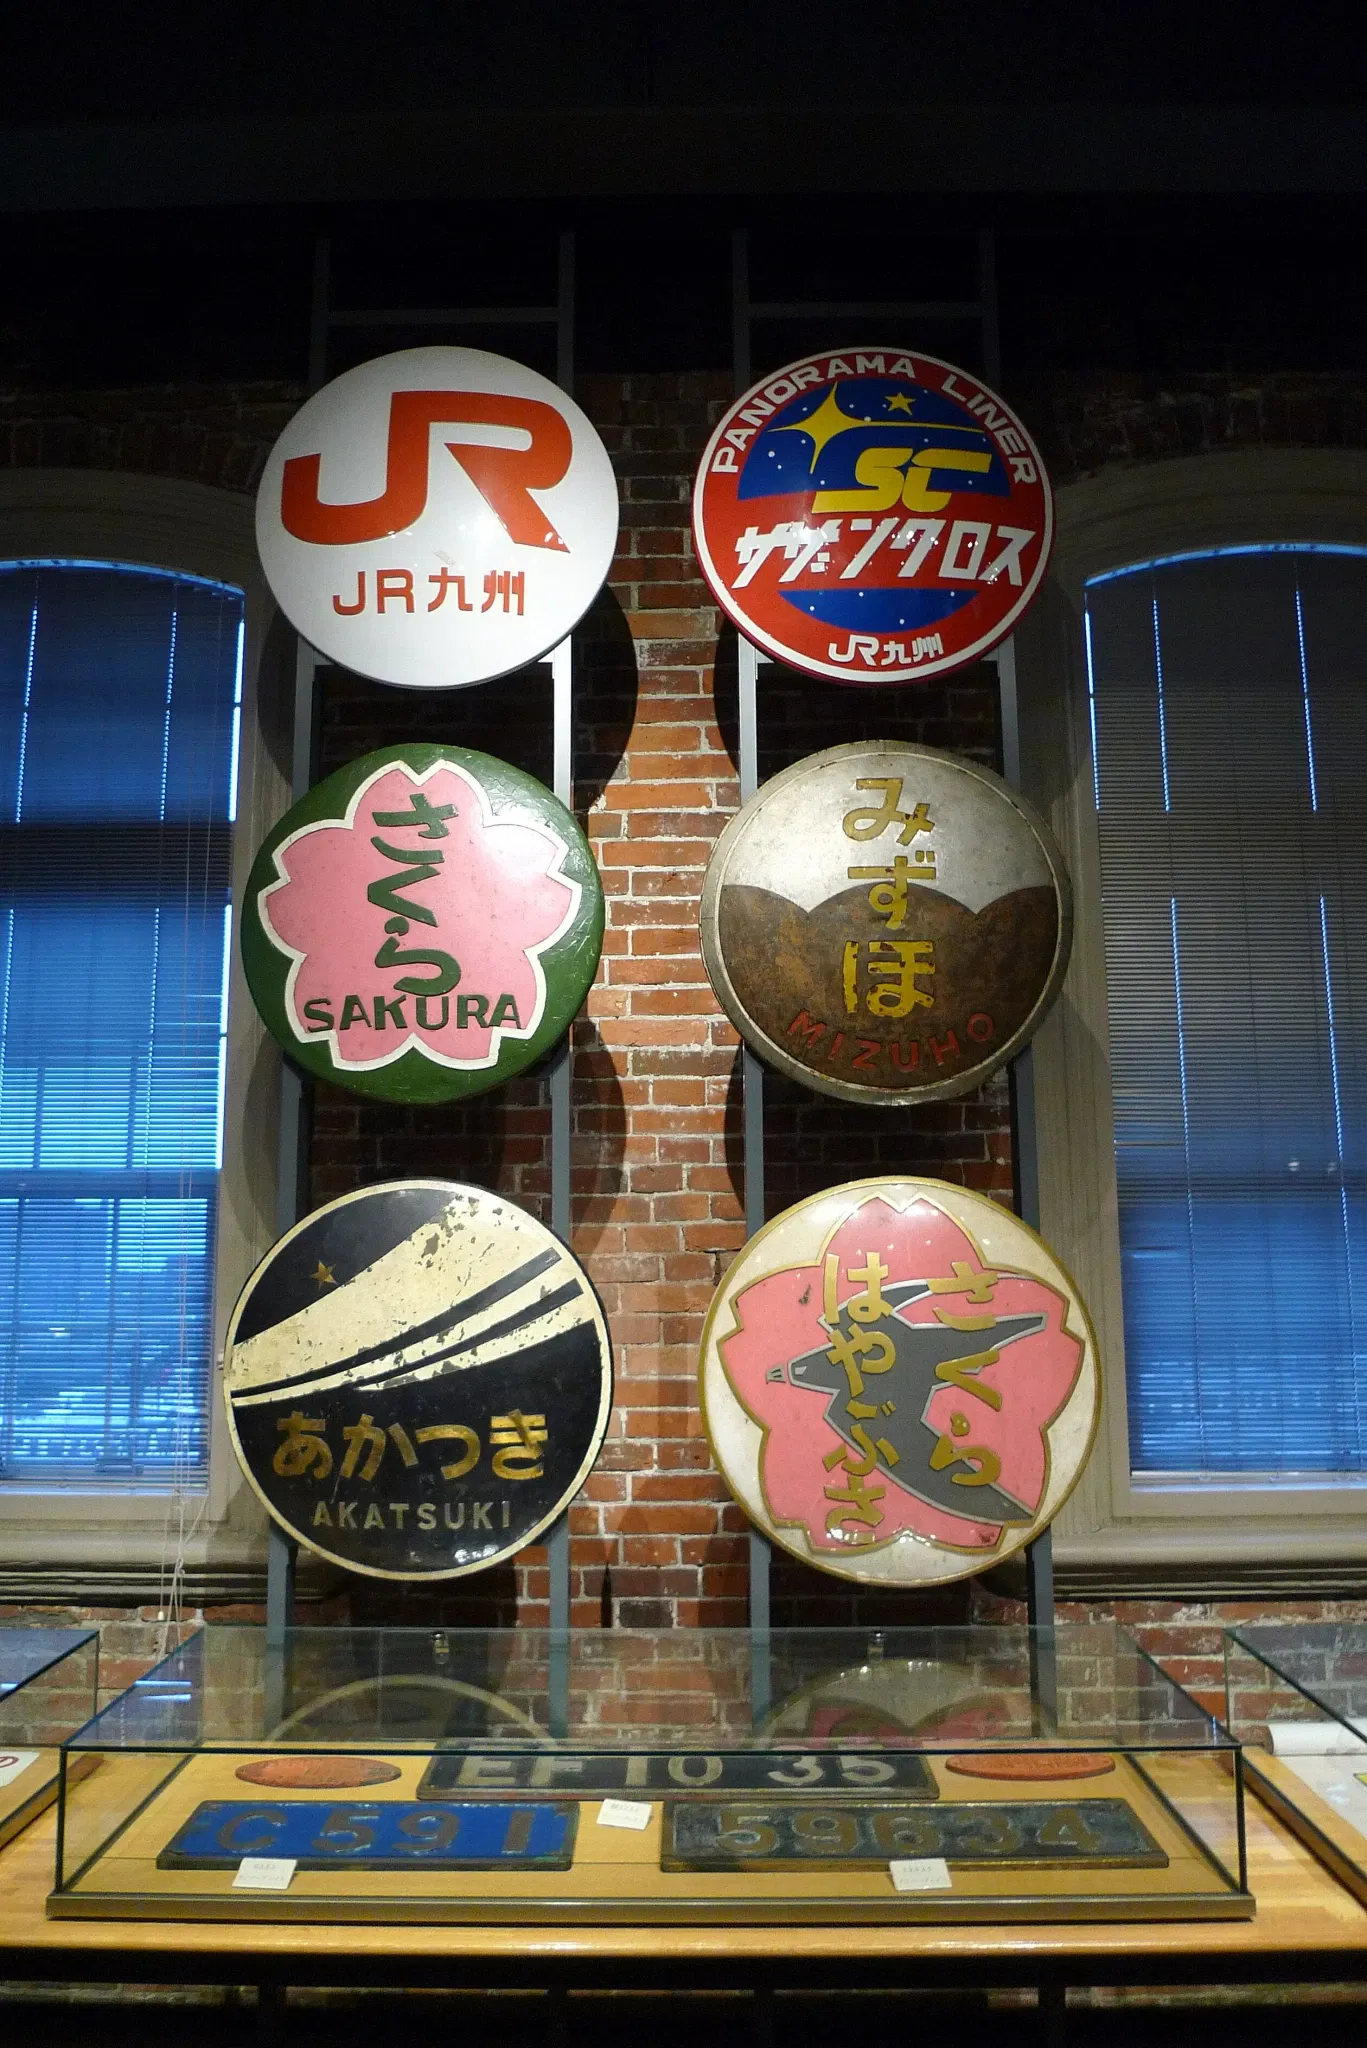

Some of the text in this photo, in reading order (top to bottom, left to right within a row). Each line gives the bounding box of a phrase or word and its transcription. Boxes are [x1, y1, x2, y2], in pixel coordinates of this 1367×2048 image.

[711, 355, 1037, 485] PANORAMA LINER
[281, 390, 573, 554] JR
[811, 447, 993, 514] SC
[731, 517, 1037, 589] サザンクロス
[333, 566, 525, 616] JR九州
[828, 632, 944, 667] JR九州
[367, 792, 462, 997] さくら
[842, 777, 936, 1018] みずほ
[303, 993, 522, 1033] SAKURA
[786, 1008, 995, 1072] MIZUHO
[822, 1251, 899, 1545] はやぶさ
[926, 1261, 1003, 1488] さくら
[272, 1408, 549, 1482] あかつき
[312, 1500, 511, 1531] AKATSUKI
[715, 1807, 1102, 1855] 59634
